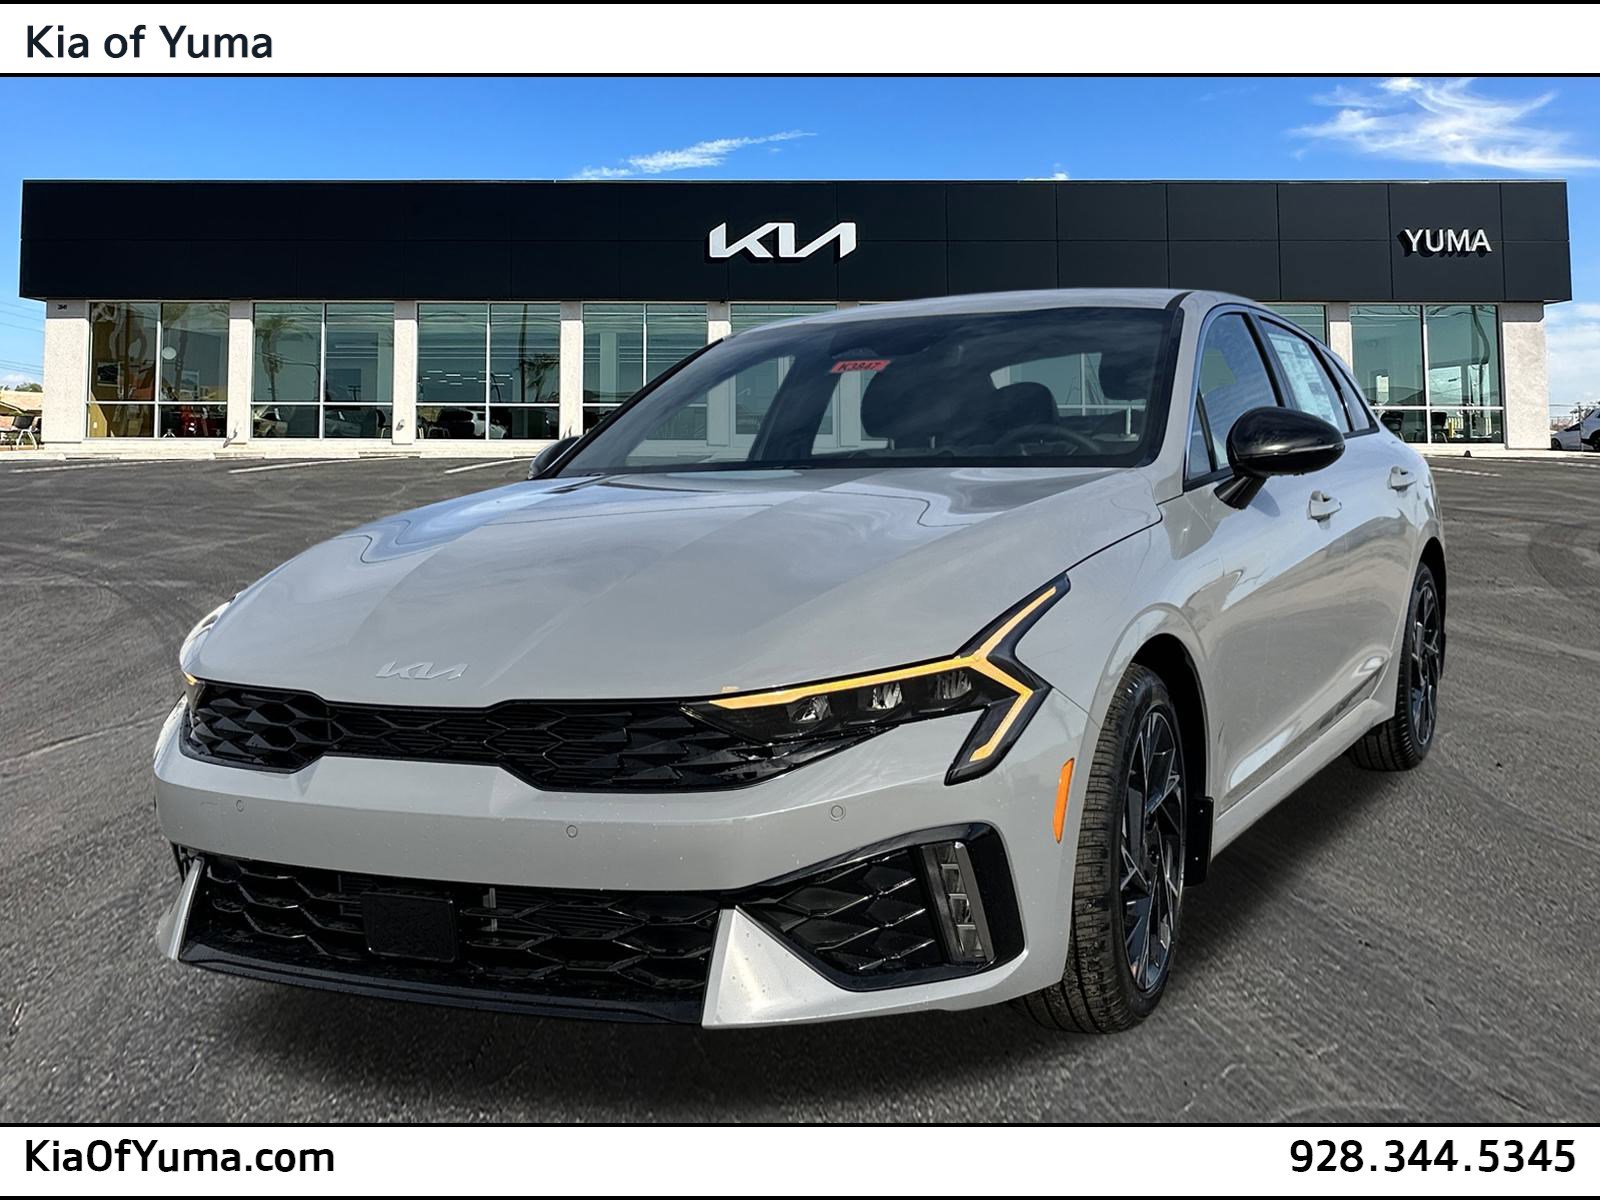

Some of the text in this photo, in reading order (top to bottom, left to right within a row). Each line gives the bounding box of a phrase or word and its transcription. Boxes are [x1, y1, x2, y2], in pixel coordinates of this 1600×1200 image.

[708, 222, 857, 258] KIA
[1404, 228, 1493, 253] YUMA
[375, 661, 468, 680] KIA
